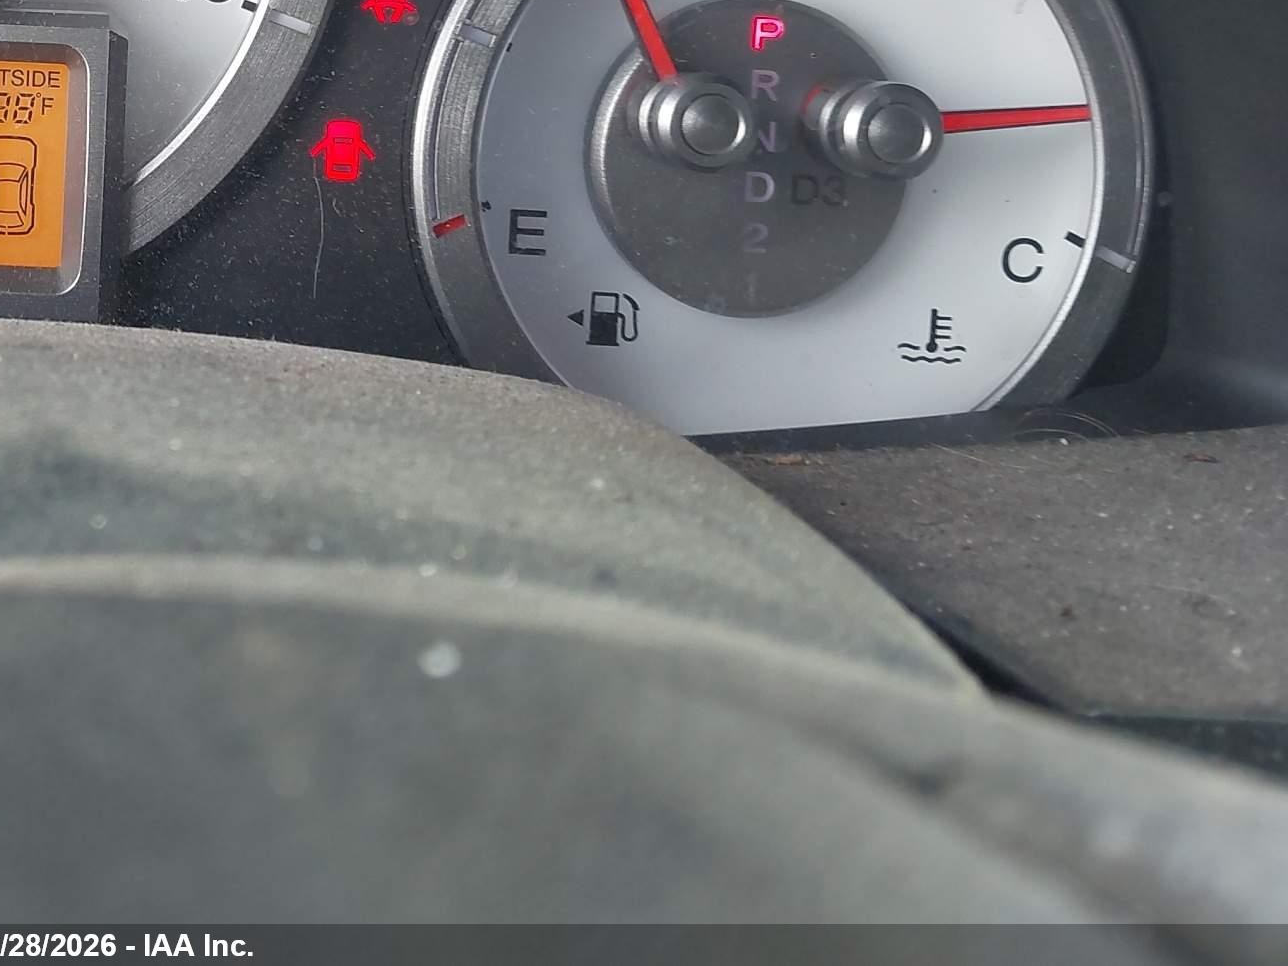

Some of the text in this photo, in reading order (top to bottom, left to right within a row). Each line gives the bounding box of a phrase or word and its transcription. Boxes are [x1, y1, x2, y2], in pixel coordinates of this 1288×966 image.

[752, 16, 784, 50] P
[751, 69, 780, 102] R
[744, 171, 775, 203] D
[791, 174, 846, 205] D3
[508, 208, 548, 256] E
[743, 223, 770, 253] 2
[1002, 237, 1044, 285] C
